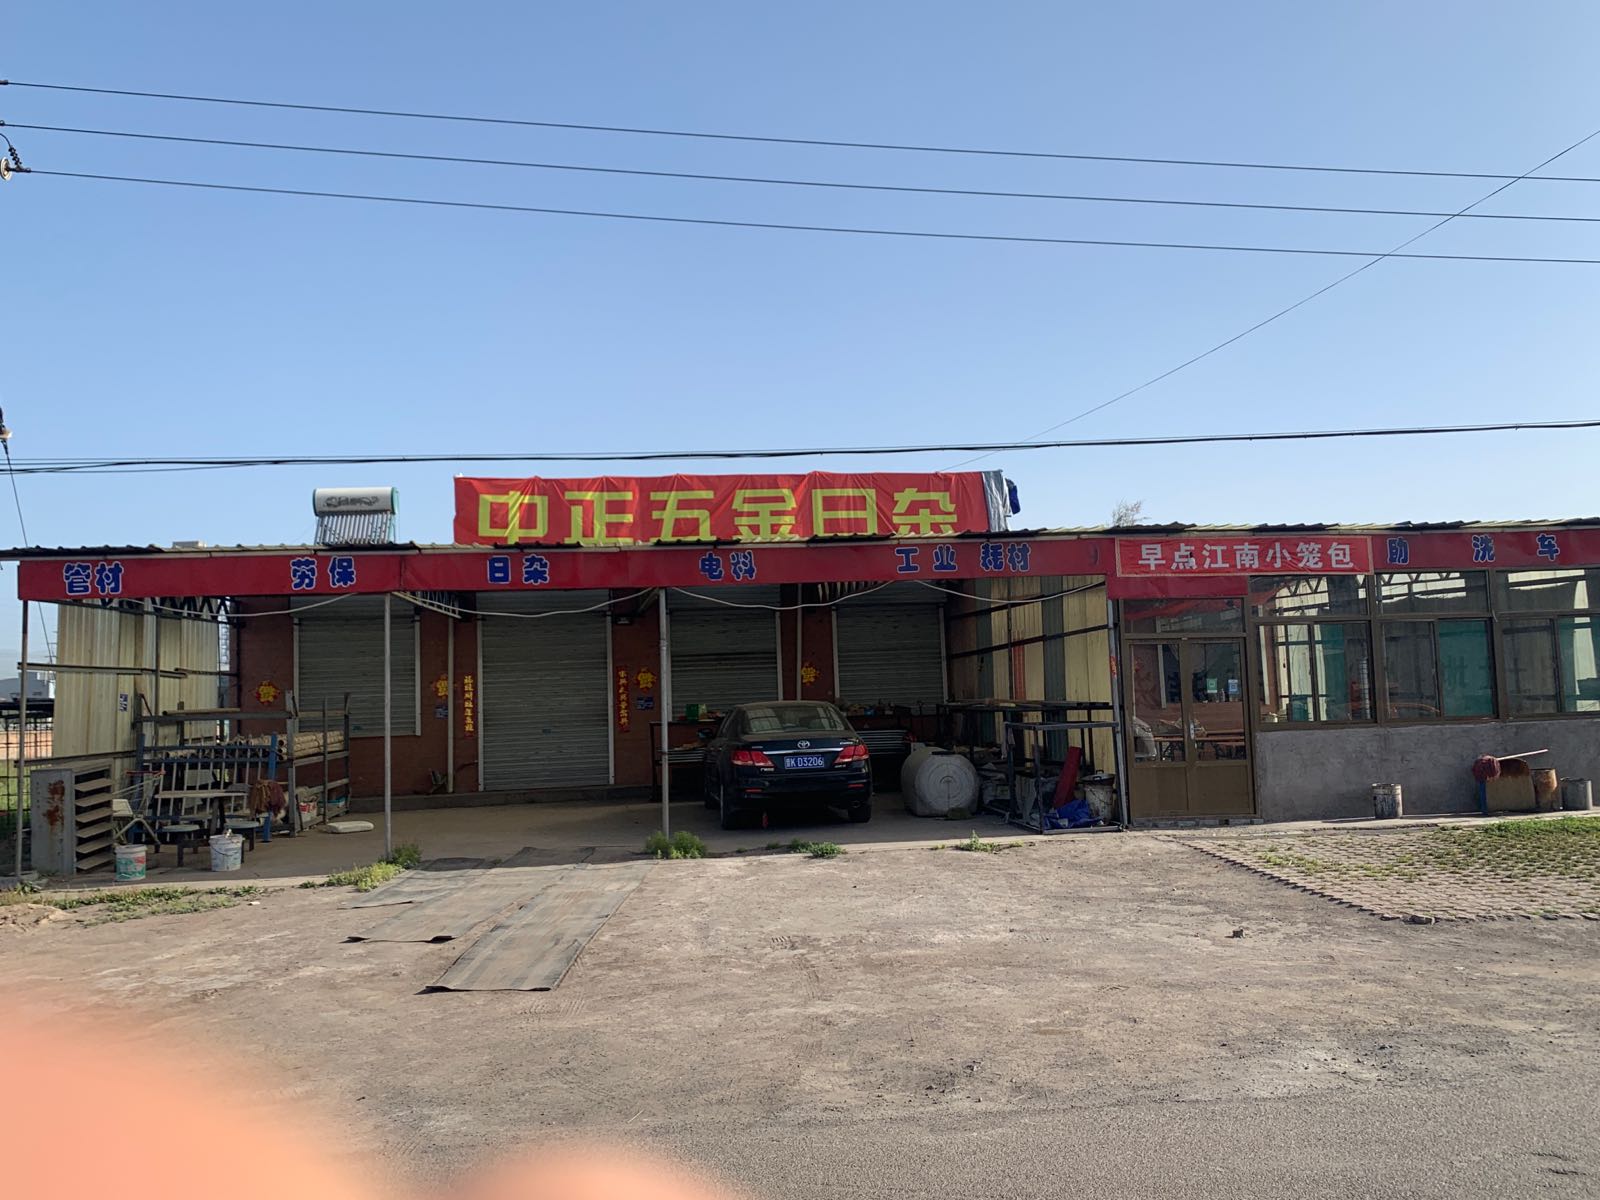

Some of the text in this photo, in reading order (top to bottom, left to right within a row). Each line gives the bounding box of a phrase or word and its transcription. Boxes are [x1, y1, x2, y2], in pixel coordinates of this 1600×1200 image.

[477, 487, 957, 544] 中正五金日杂
[63, 541, 1032, 596] 管材 劳保 日杂 电料 工业 耗材
[1138, 542, 1355, 571] 早点江南小笼包
